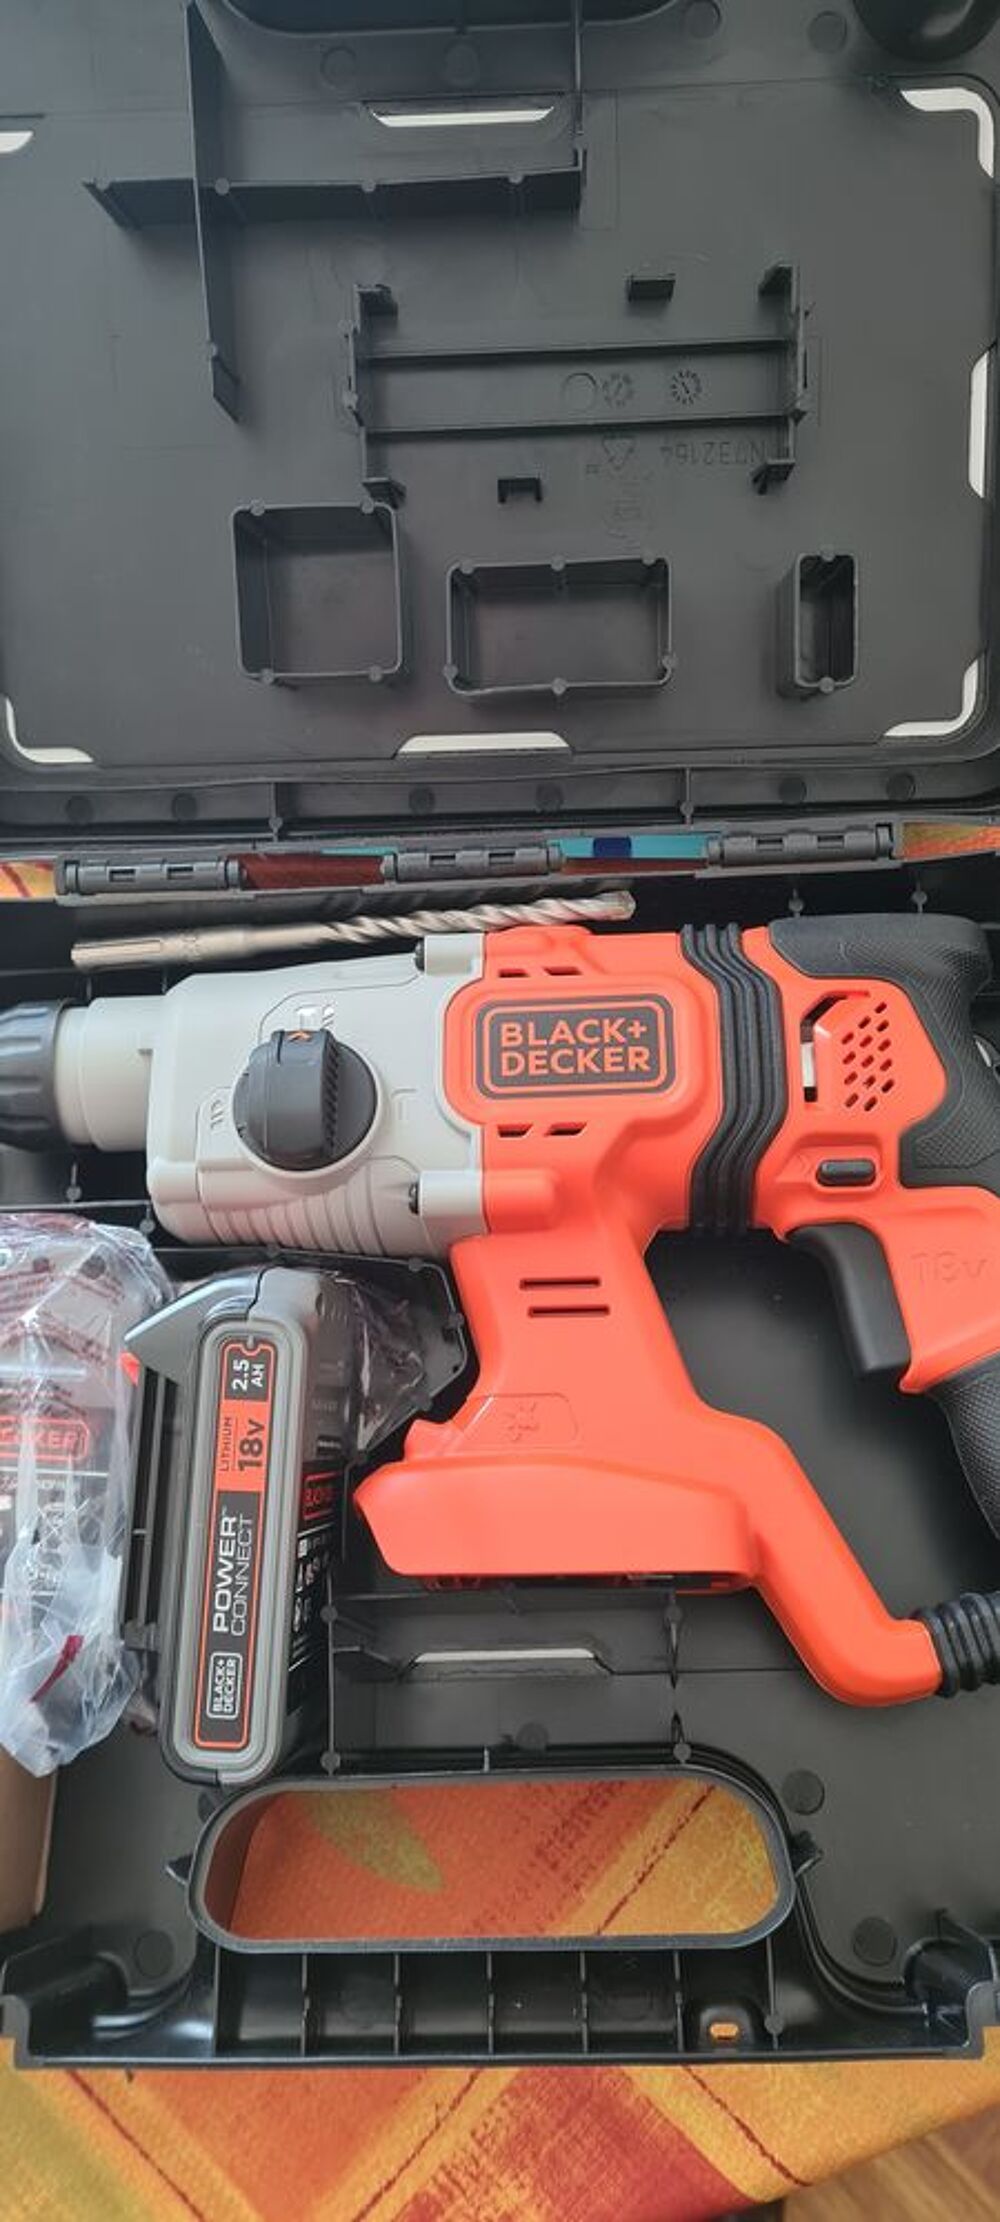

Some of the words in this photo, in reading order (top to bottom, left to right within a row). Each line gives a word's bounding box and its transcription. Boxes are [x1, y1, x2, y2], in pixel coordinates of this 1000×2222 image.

[501, 1017, 648, 1048] BLACK+
[501, 1045, 651, 1077] DECKER
[231, 1359, 250, 1391] 2.5
[250, 1363, 265, 1387] AH
[219, 1417, 232, 1471] LITHIUM
[230, 1514, 253, 1637] CONNECT
[212, 1658, 225, 1712] BLACK+
[223, 1658, 236, 1713] DECKER
